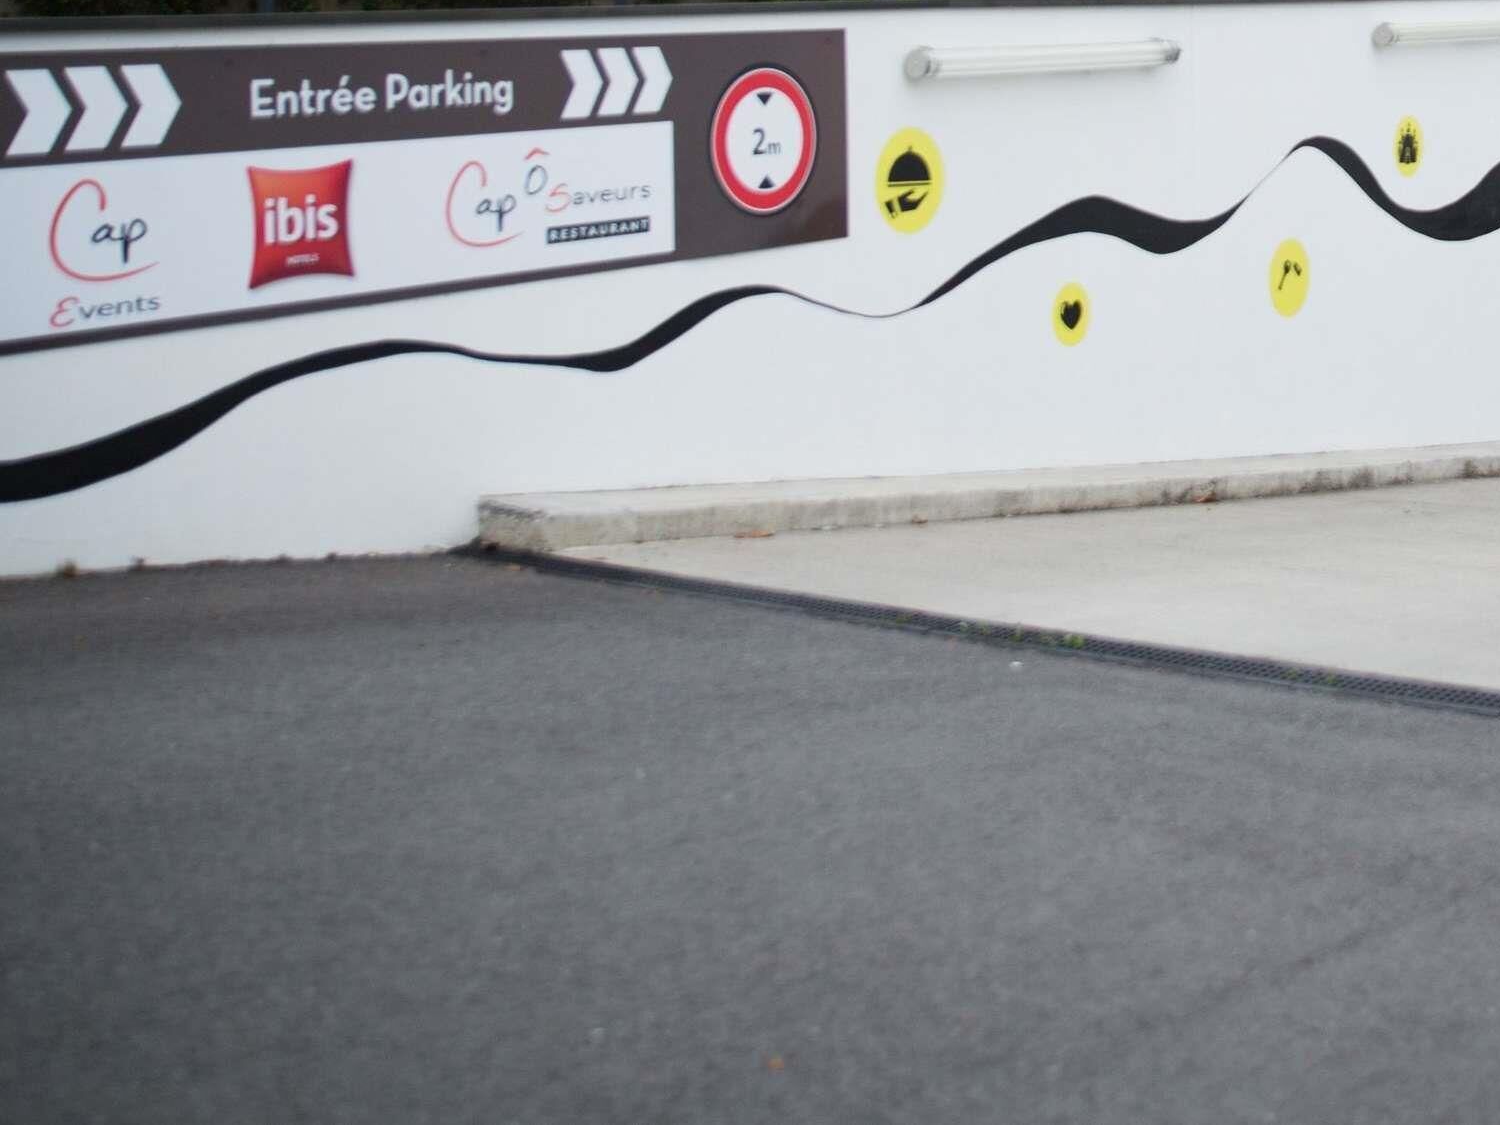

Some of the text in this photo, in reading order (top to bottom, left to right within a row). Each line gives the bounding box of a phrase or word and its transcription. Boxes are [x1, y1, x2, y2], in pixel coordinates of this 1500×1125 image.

[250, 69, 514, 118] Entrée Parking
[263, 194, 339, 244] ibis
[445, 160, 524, 248] Cap
[545, 183, 651, 213] Saveurs
[49, 178, 160, 282] Cap
[549, 219, 650, 242] RESTAURANT
[50, 295, 161, 327] Events
